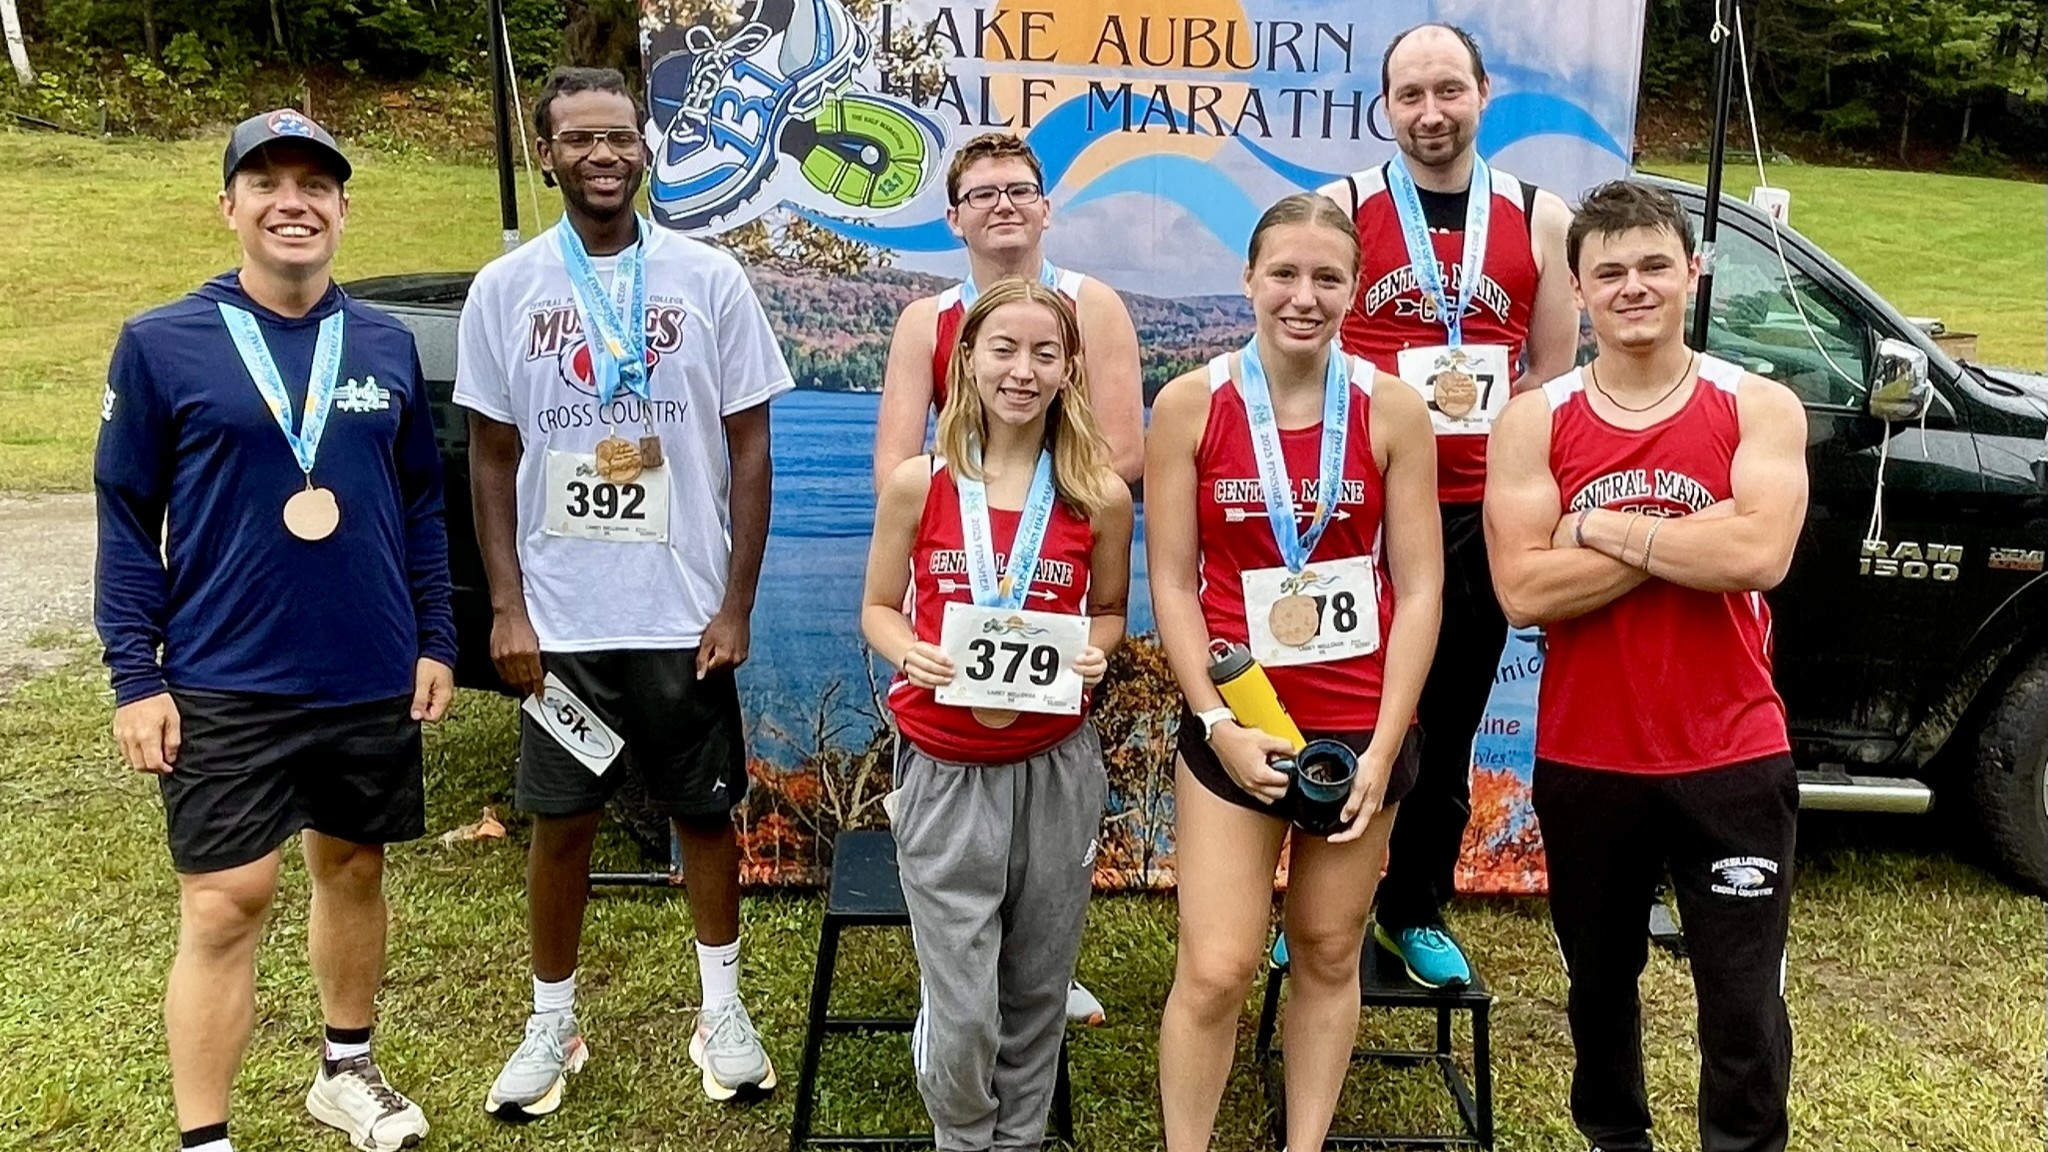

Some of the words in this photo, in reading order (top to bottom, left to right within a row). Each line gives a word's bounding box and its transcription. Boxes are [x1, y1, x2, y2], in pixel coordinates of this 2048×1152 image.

[881, 4, 1059, 62] LAKE
[1089, 15, 1354, 73] AUBURN
[880, 71, 1056, 128] HALF
[878, 172, 905, 197] 13.1
[617, 281, 626, 304] 2025
[1366, 262, 1449, 317] CENTL
[1336, 373, 1348, 426] MARATHON
[538, 403, 593, 433] CROSS
[599, 401, 688, 424] COUNTRY
[1335, 431, 1346, 457] HALF
[1260, 433, 1272, 460] 2025
[1266, 460, 1284, 509] FINISHER
[566, 481, 645, 520] 392
[1571, 469, 1650, 511] ENTRAL
[1655, 469, 1716, 511] MAIN
[971, 518, 981, 543] 2025
[1034, 504, 1047, 531] HALF
[1861, 539, 1964, 563] RAM
[975, 545, 990, 592] FINISHER
[1033, 560, 1074, 586] AINE
[1859, 557, 1960, 581] 1500
[966, 639, 1059, 685] 379
[1477, 713, 1521, 735] ine
